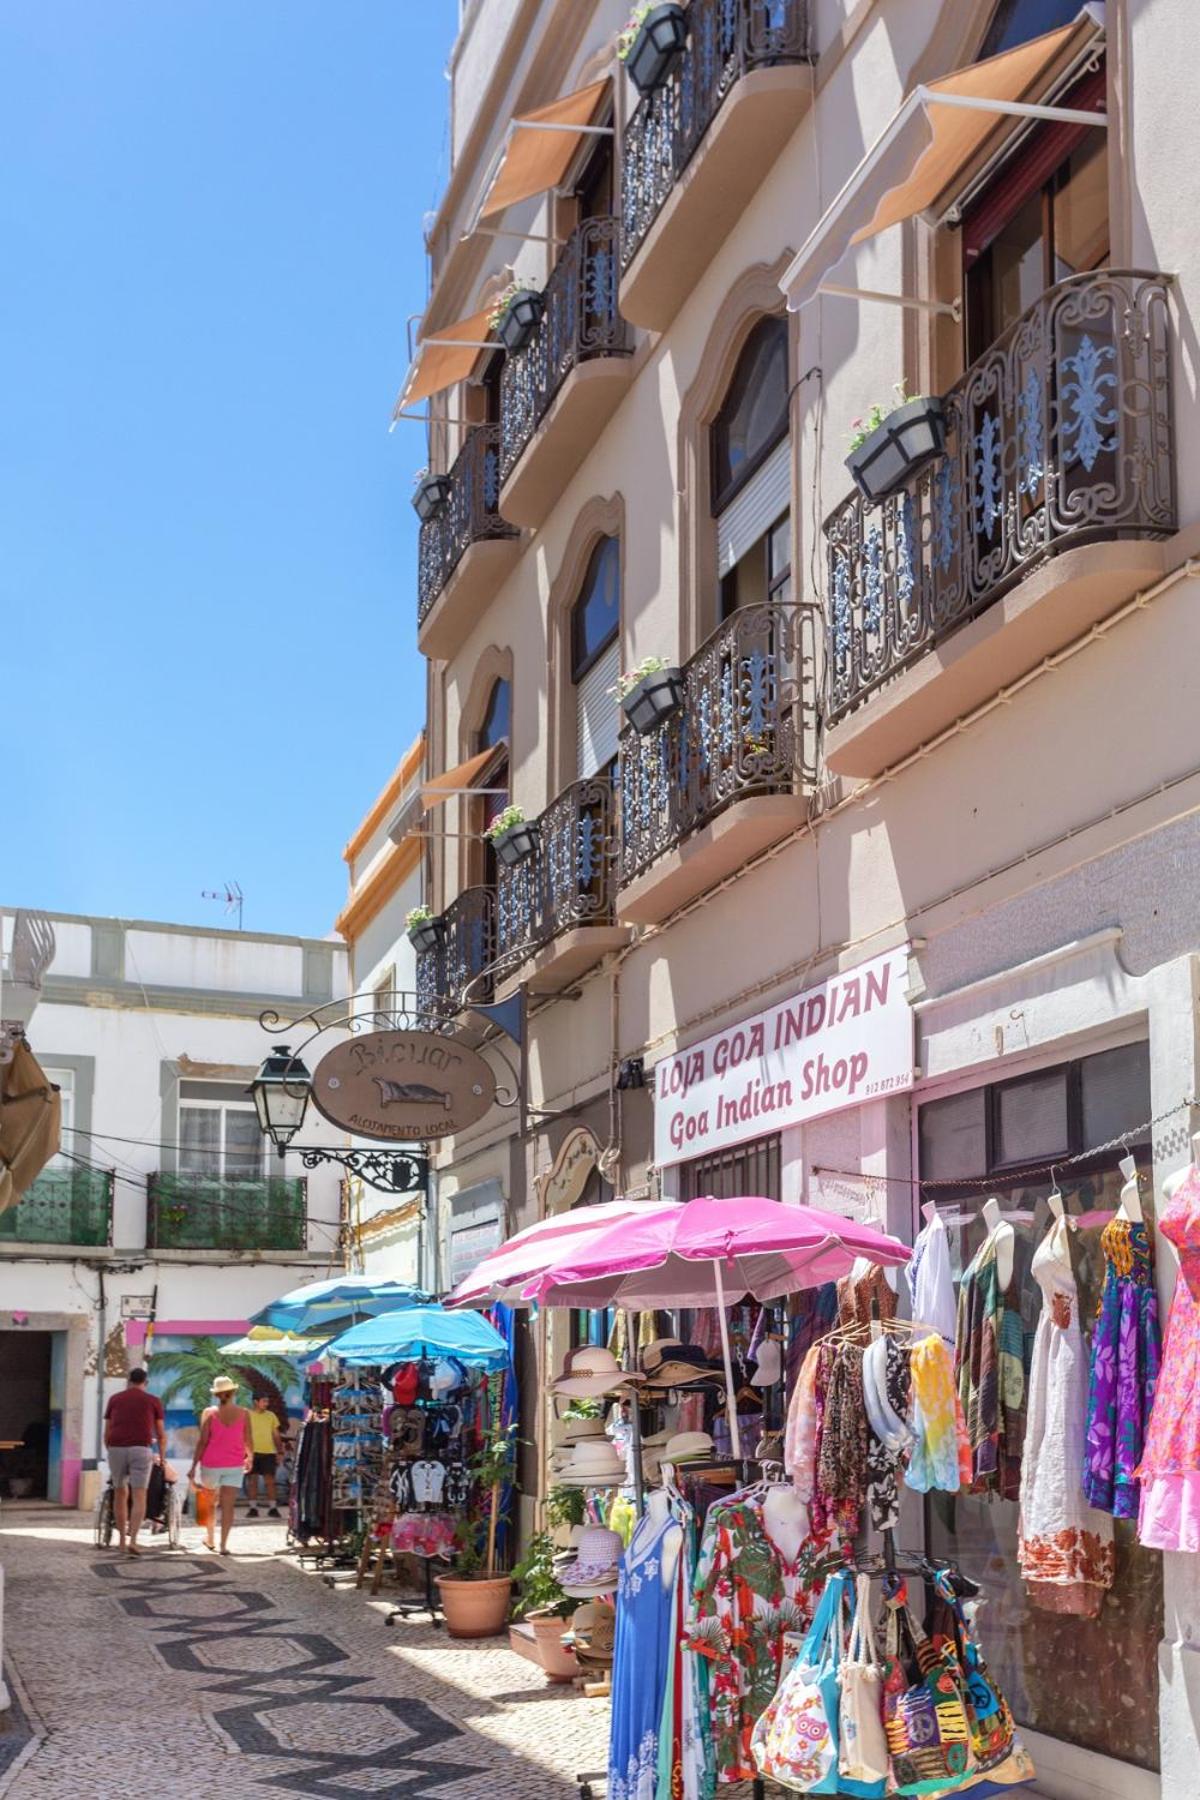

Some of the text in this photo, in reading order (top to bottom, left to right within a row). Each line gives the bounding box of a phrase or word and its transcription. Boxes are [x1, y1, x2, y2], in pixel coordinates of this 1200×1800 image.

[660, 963, 891, 1099] LOJA GOA INDIAN
[425, 1119, 459, 1135] LOCAL
[670, 1051, 868, 1150] Goa Indian Shop
